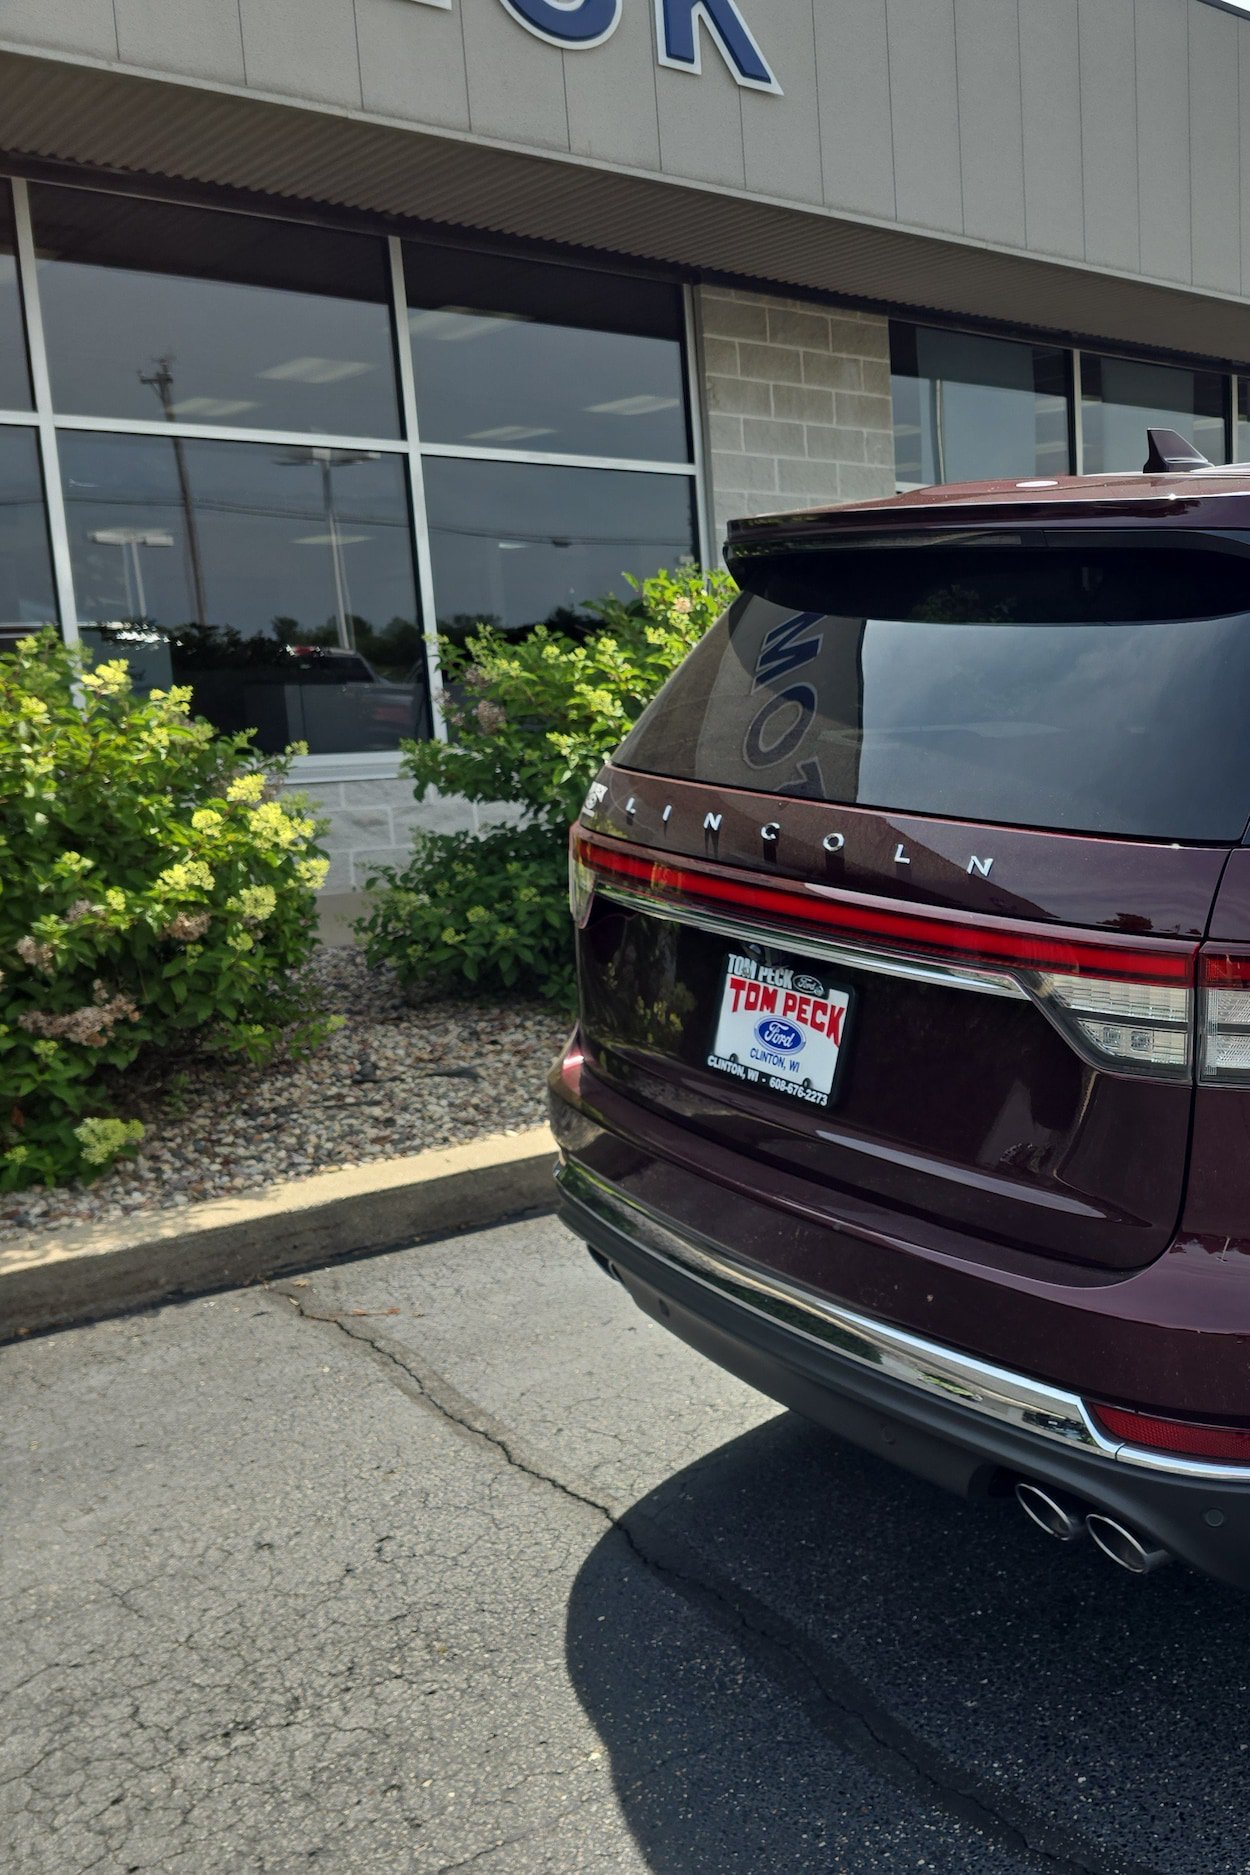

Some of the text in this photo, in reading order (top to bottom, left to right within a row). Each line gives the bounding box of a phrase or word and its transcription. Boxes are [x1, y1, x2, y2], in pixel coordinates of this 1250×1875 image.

[624, 797, 994, 877] LINCOLN
[727, 953, 757, 980] TOM
[758, 964, 795, 990] PECK
[730, 977, 846, 1048] TOM PECK
[763, 1021, 796, 1048] Ford
[707, 1055, 747, 1080] CLINTON,
[747, 1069, 759, 1082] WI
[769, 1076, 829, 1107] 608-676-2273
[749, 1047, 800, 1073] CLINTON, WI
